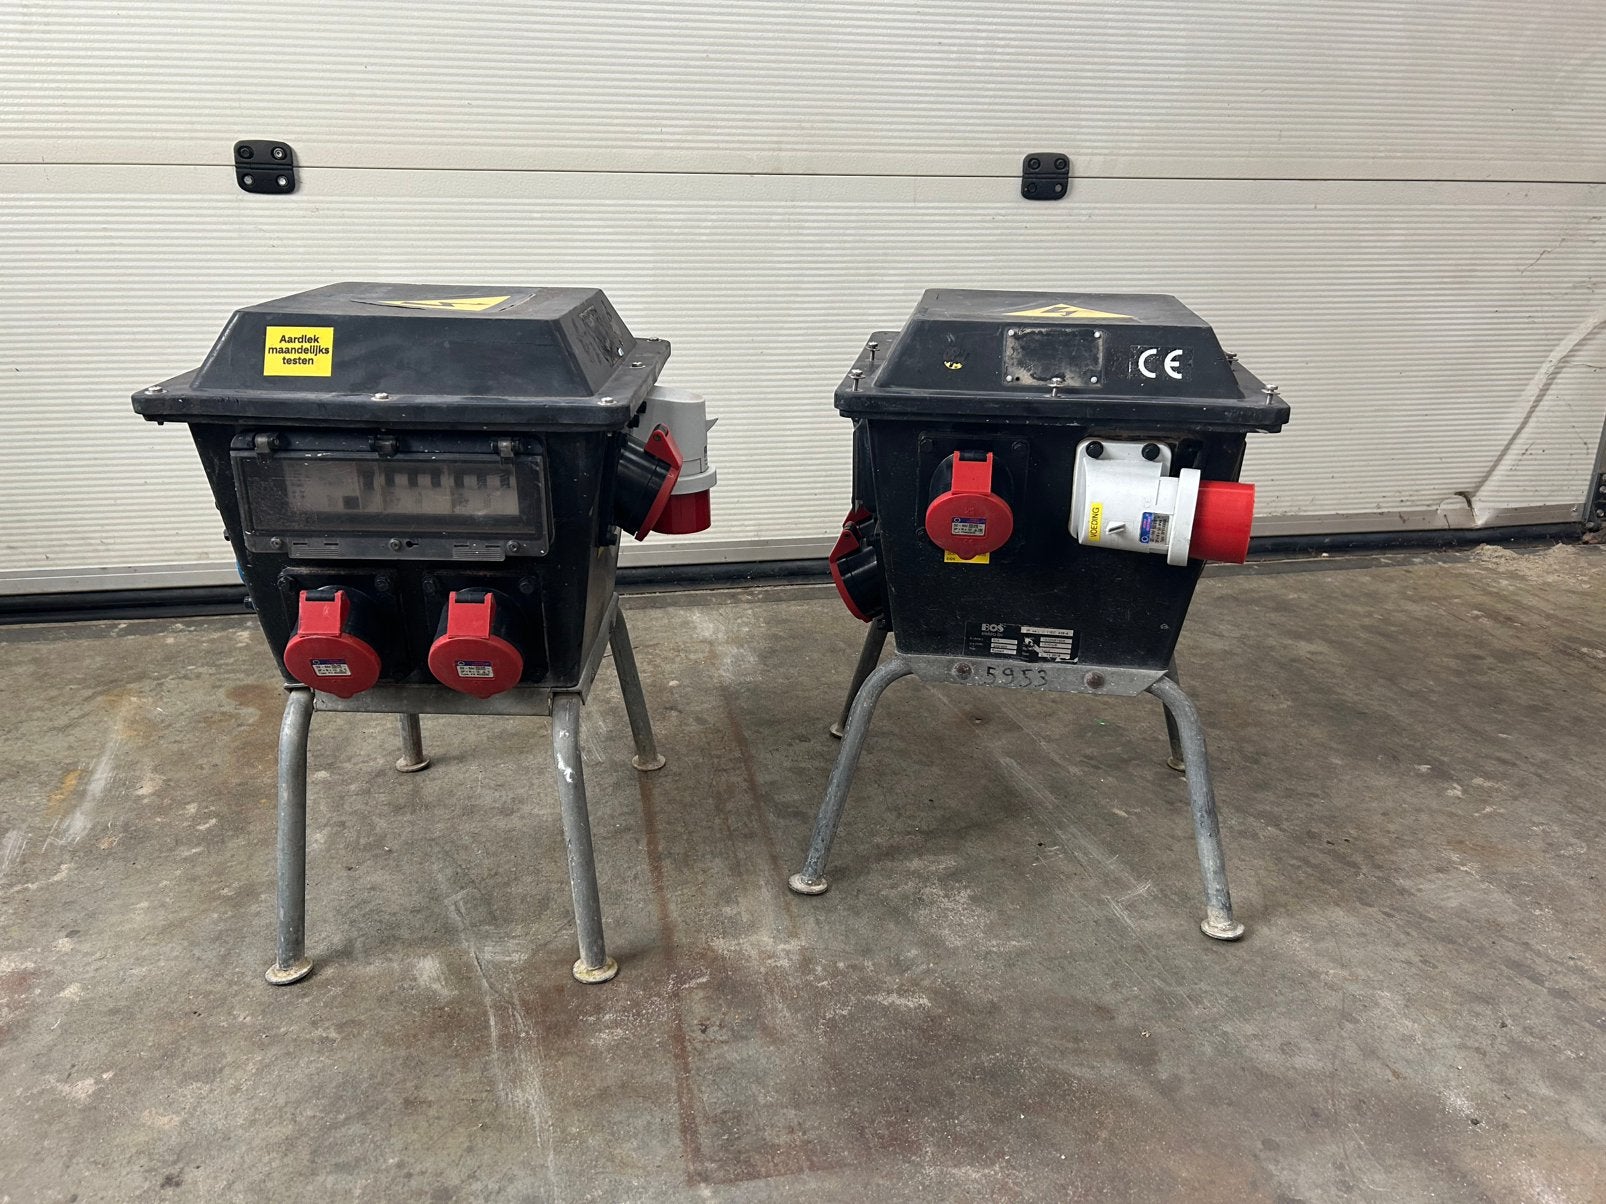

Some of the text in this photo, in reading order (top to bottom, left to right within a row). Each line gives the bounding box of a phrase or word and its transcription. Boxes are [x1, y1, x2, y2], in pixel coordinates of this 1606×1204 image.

[279, 334, 320, 344] Aardlek
[267, 345, 330, 356] maandelijks
[282, 356, 314, 365] testen
[1138, 348, 1183, 379] CE
[1089, 507, 1100, 538] VOEDING
[981, 623, 1004, 633] BOS
[983, 666, 1048, 688] 5953
